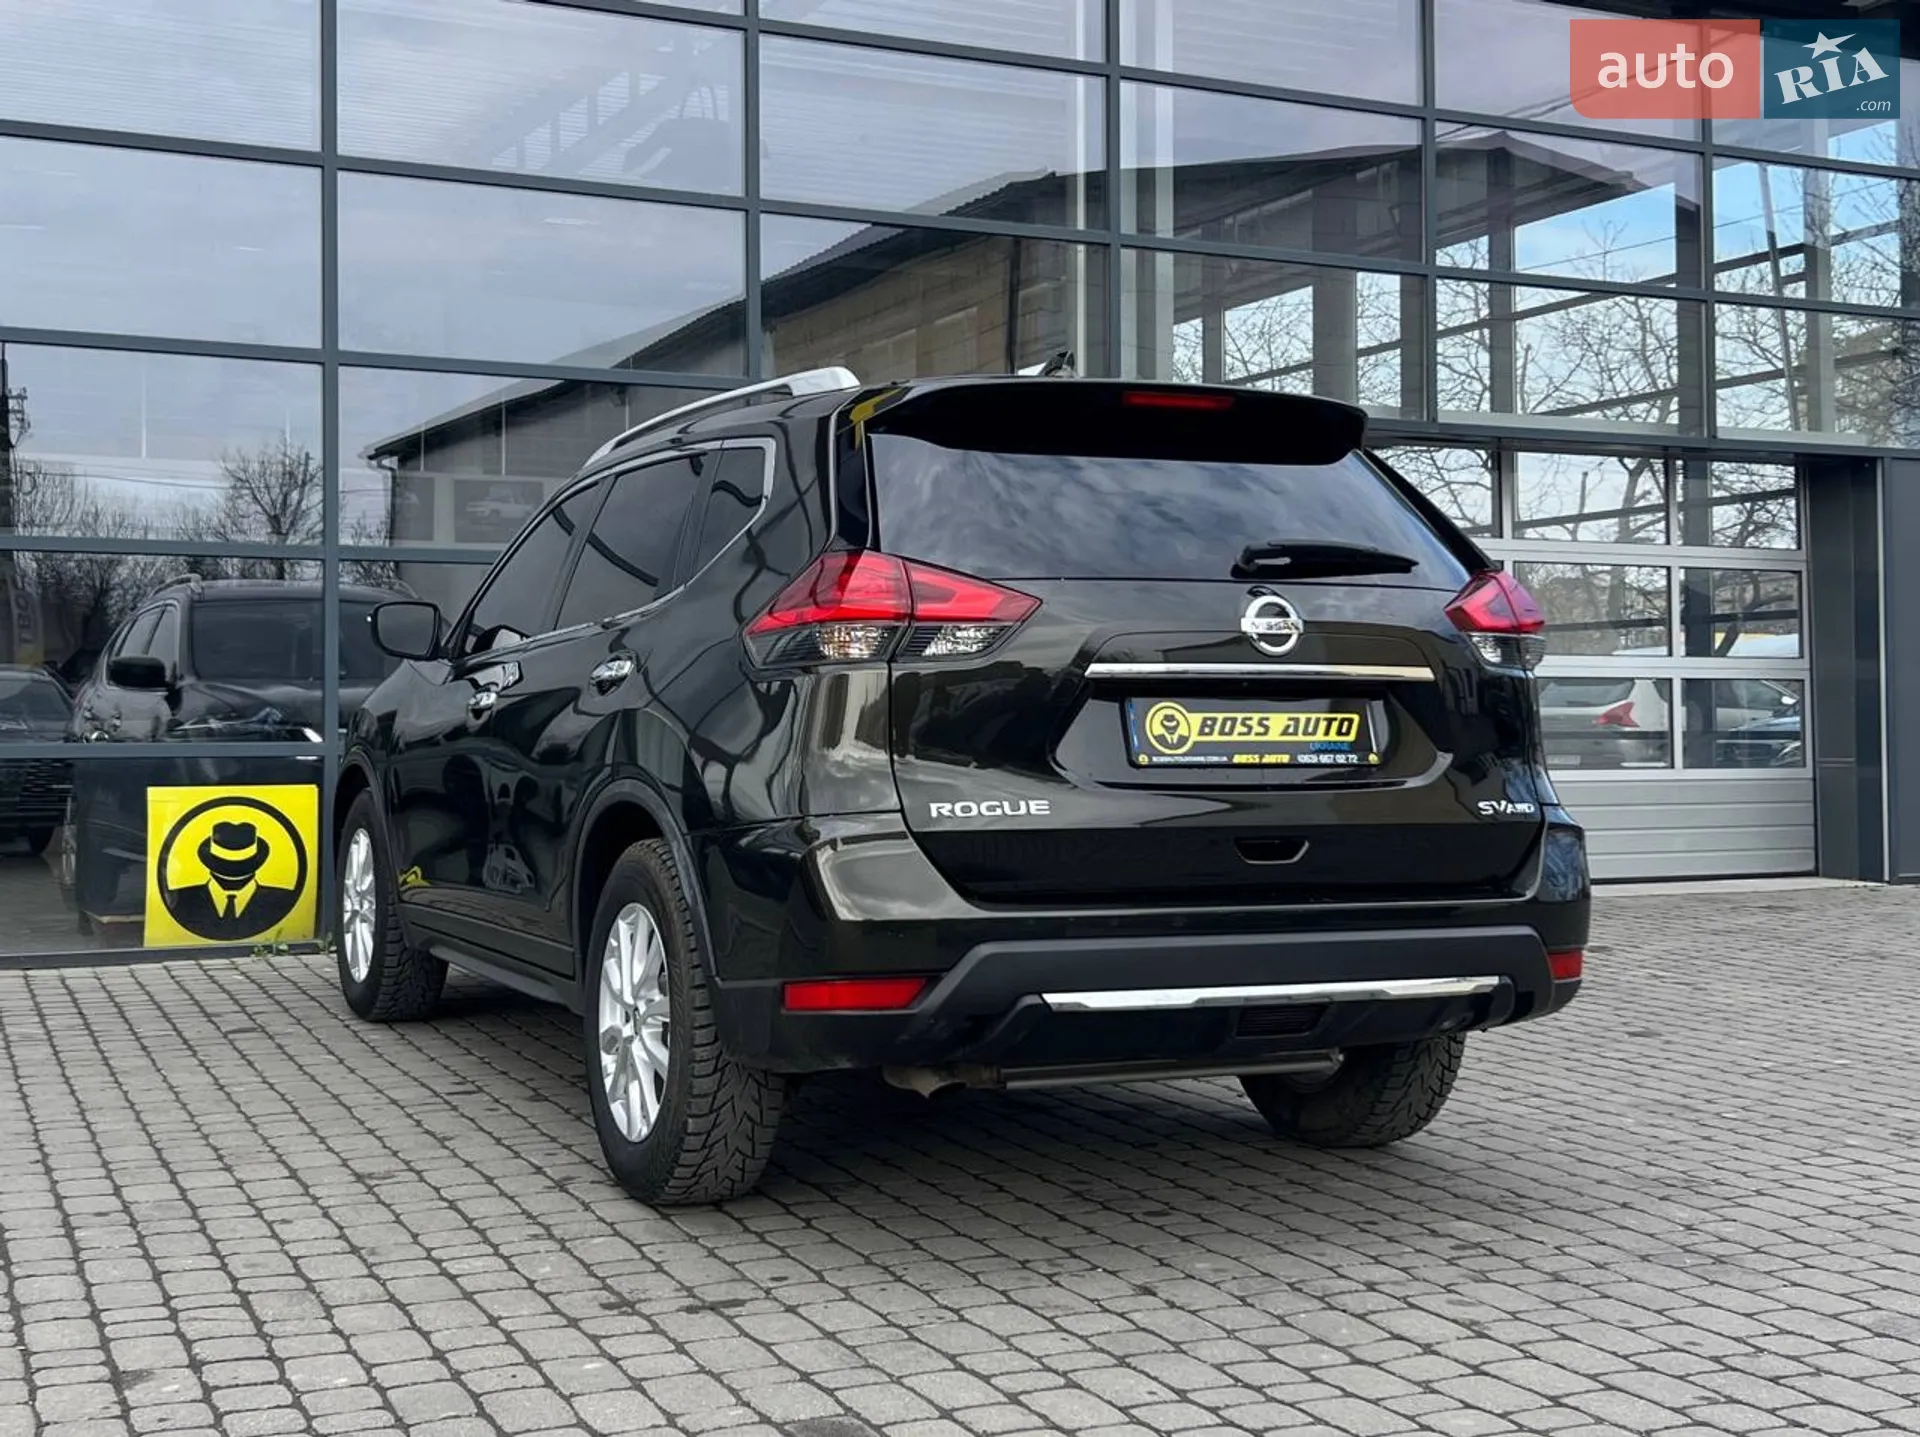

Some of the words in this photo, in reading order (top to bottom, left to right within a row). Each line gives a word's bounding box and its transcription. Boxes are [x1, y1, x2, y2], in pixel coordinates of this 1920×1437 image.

[1197, 716, 1272, 737] BOSS
[1279, 716, 1357, 737] AUTO
[929, 800, 1051, 818] ROGUE
[1478, 800, 1507, 815] SV
